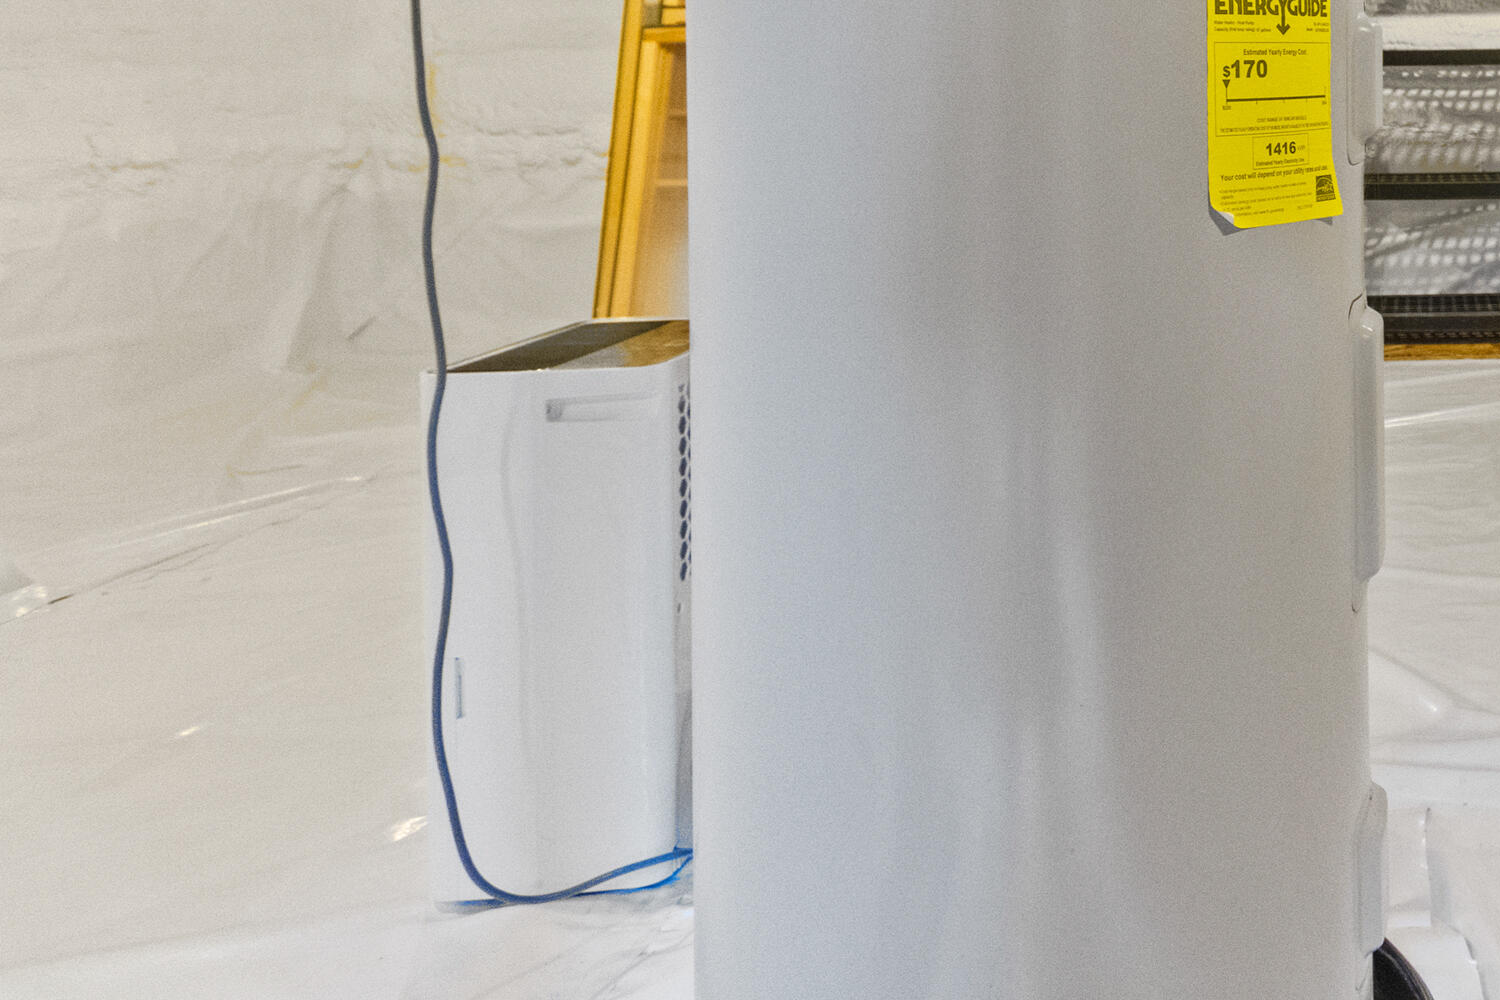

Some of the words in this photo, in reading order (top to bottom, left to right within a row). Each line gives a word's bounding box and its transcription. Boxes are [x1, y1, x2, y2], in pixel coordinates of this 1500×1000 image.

[1222, 59, 1268, 79] $170
[1265, 141, 1297, 157] 1416
[1220, 174, 1234, 182] Your
